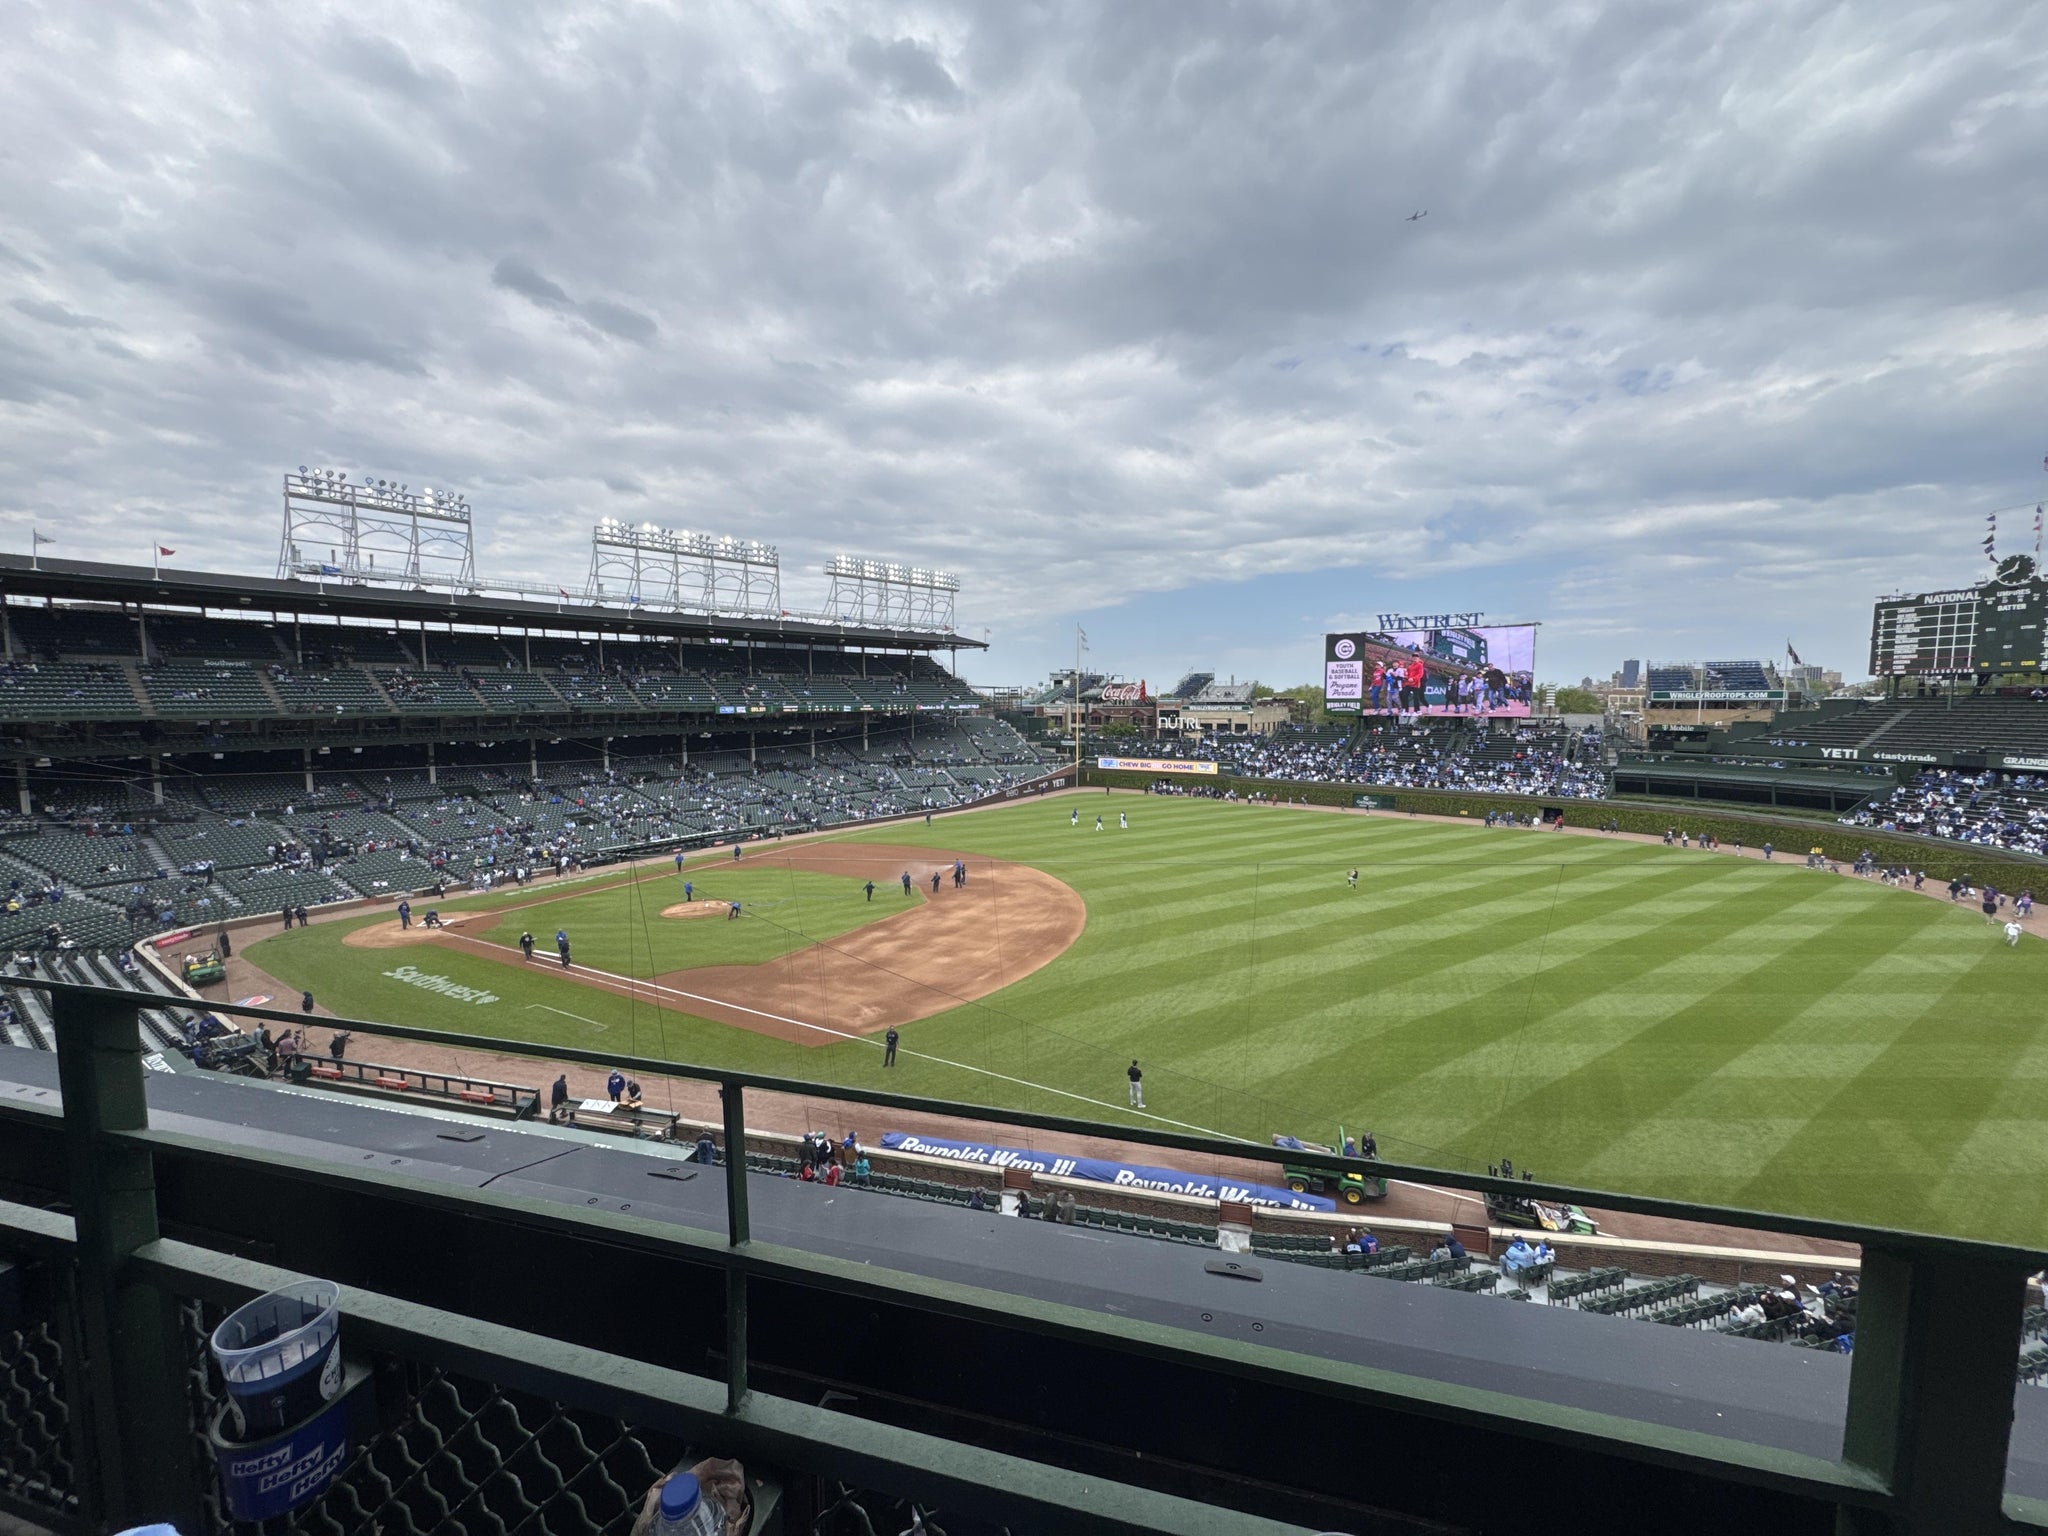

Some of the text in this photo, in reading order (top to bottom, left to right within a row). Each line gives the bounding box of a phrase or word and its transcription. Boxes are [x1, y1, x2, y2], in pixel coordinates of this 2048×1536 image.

[1924, 591, 1981, 604] NATIONAL
[1376, 612, 1484, 630] WINTRUST
[1820, 748, 1858, 760] YETI
[1881, 752, 1937, 763] tastytrade
[381, 966, 490, 1001] Southwest
[233, 1451, 288, 1474] Hefty
[263, 1451, 320, 1490] Hefty
[296, 1447, 344, 1495] Hefty
